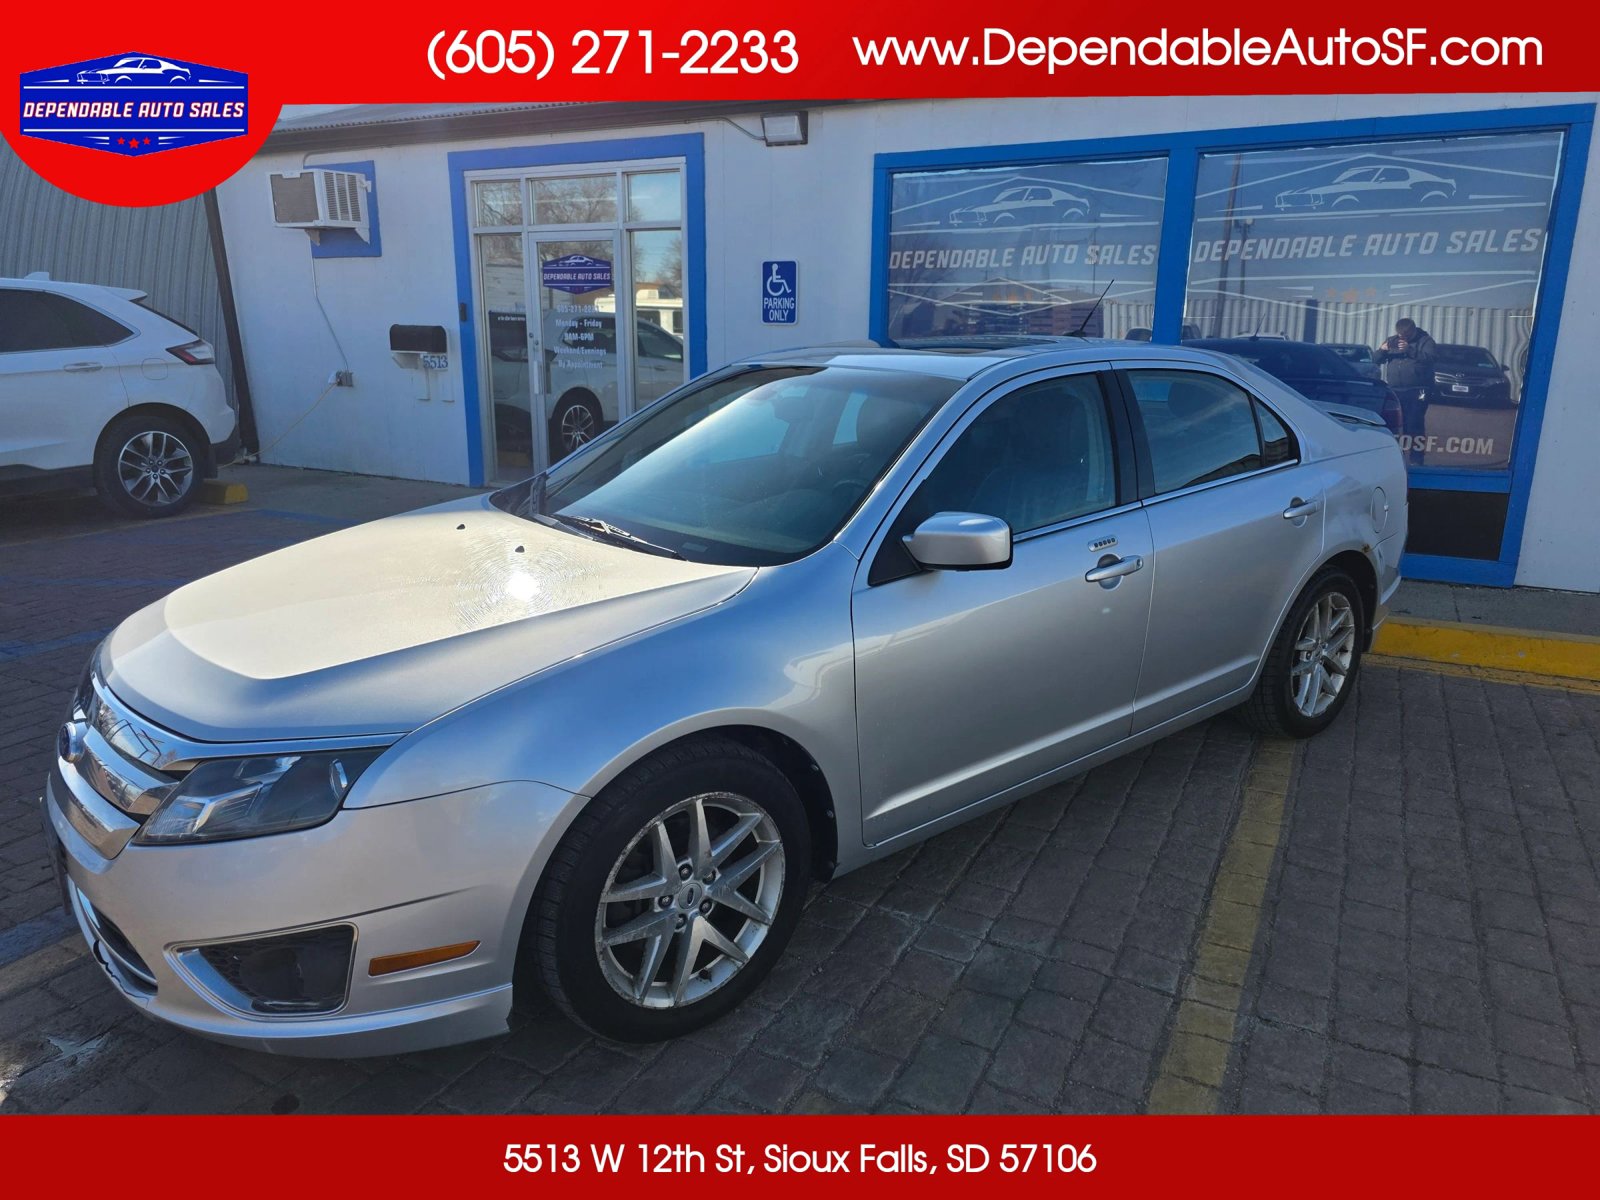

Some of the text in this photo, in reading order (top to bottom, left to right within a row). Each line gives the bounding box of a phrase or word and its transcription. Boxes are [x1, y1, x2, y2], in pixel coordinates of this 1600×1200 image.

[1194, 228, 1543, 264] DEPENDABLE AUTO SALES
[888, 244, 1158, 269] DEPENDABLE AUTO SALES
[543, 272, 611, 281] DEPENDABLE AUTO SALES
[763, 297, 795, 310] PARKING
[769, 309, 789, 321] ONLY
[583, 319, 602, 328] Friday
[423, 355, 449, 369] 5513
[1394, 434, 1494, 456] OSF.COM
